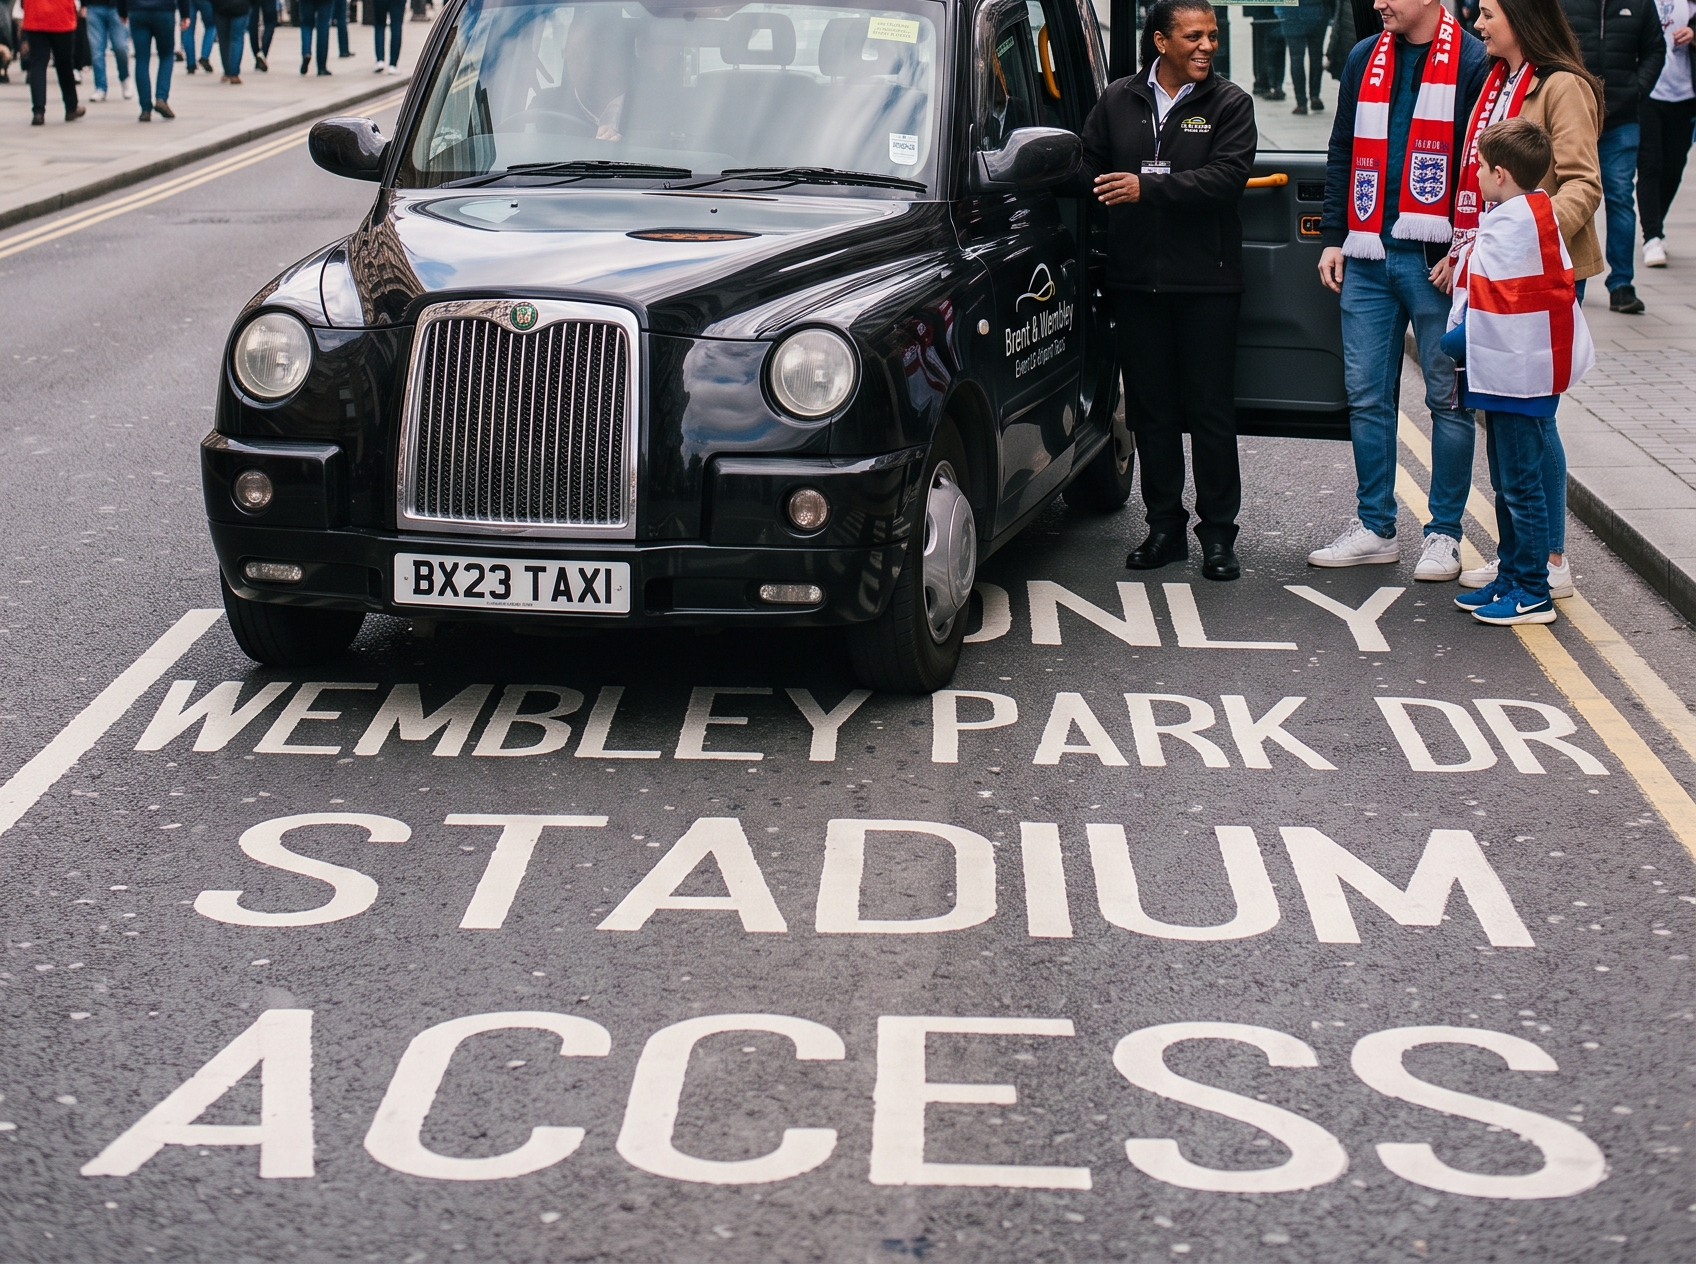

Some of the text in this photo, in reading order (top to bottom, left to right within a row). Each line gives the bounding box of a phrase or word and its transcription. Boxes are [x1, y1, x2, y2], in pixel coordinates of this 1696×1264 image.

[1005, 321, 1031, 357] Brent
[412, 559, 613, 605] BX23 TAXI
[133, 679, 1612, 776] WEMBLEY PARK DR
[193, 812, 1536, 948] STADIUM
[79, 1008, 1609, 1202] ACCESS
